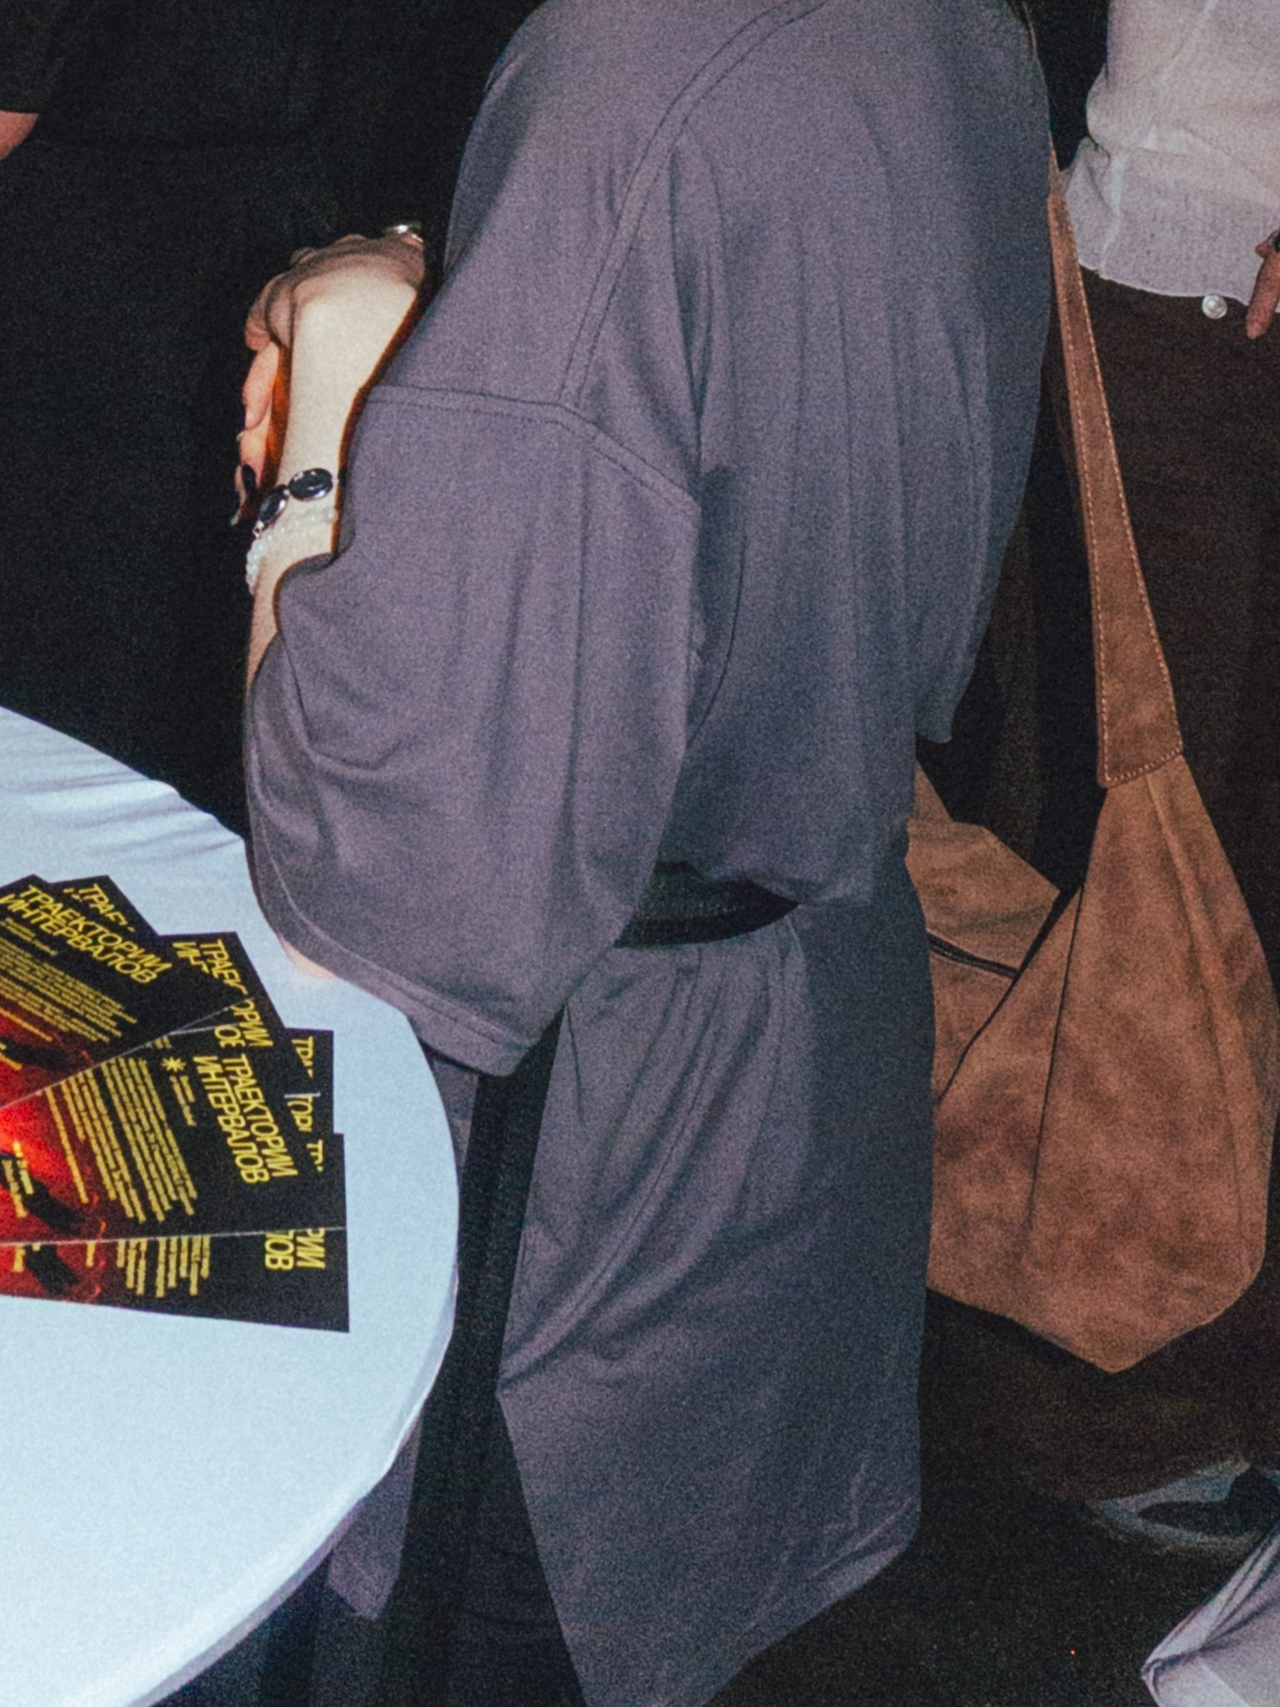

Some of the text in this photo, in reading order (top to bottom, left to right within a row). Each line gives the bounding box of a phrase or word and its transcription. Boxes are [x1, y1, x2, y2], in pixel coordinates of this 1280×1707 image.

[20, 884, 172, 973] ТРАЕКТОРИИ
[193, 1055, 270, 1184] ИНТЕРВАЛОВ
[222, 1053, 299, 1177] ТРАЕКТОРИИ
